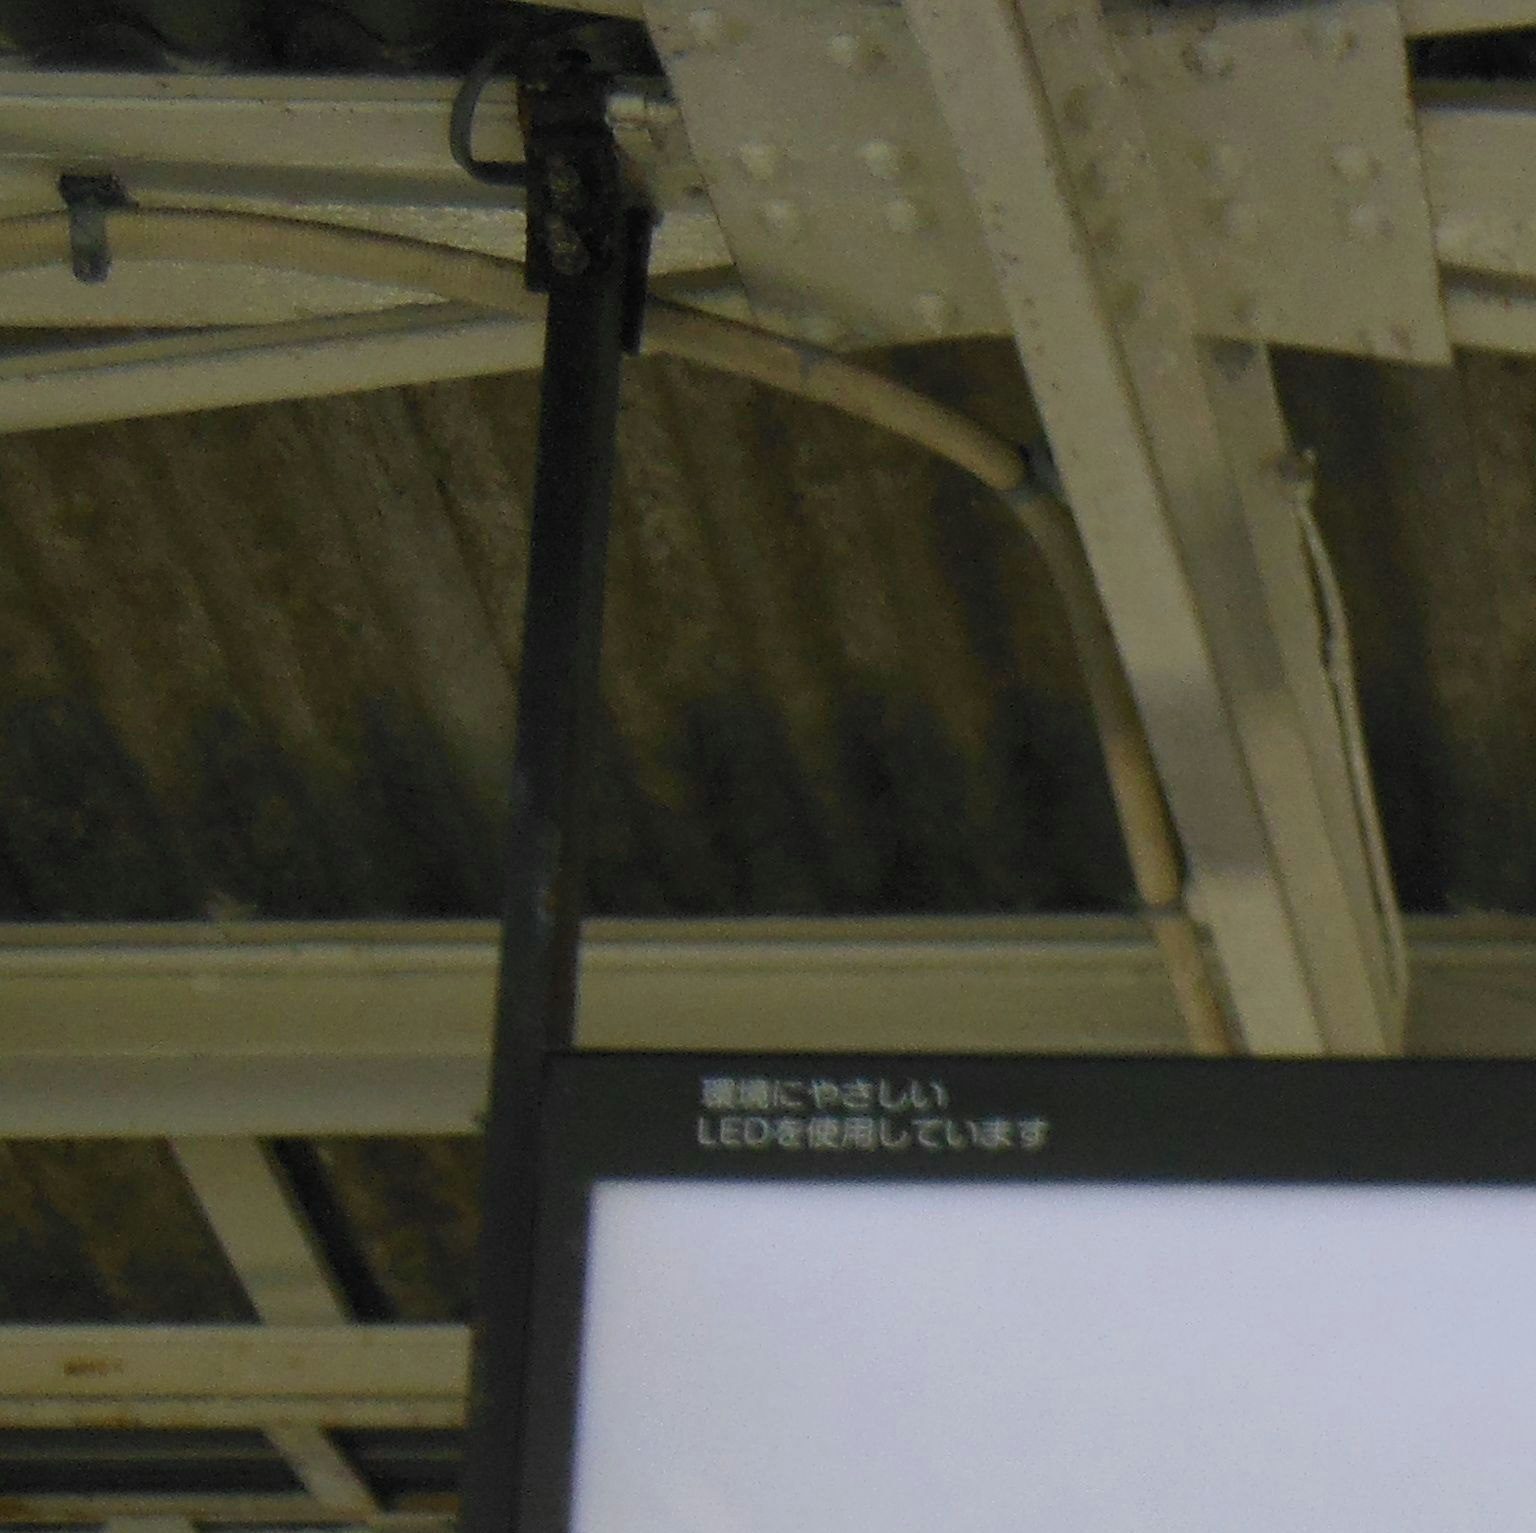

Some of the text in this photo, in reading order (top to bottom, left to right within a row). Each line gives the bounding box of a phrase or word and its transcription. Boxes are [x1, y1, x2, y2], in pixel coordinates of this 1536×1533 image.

[697, 1116, 1050, 1151] LEDを使用しています
